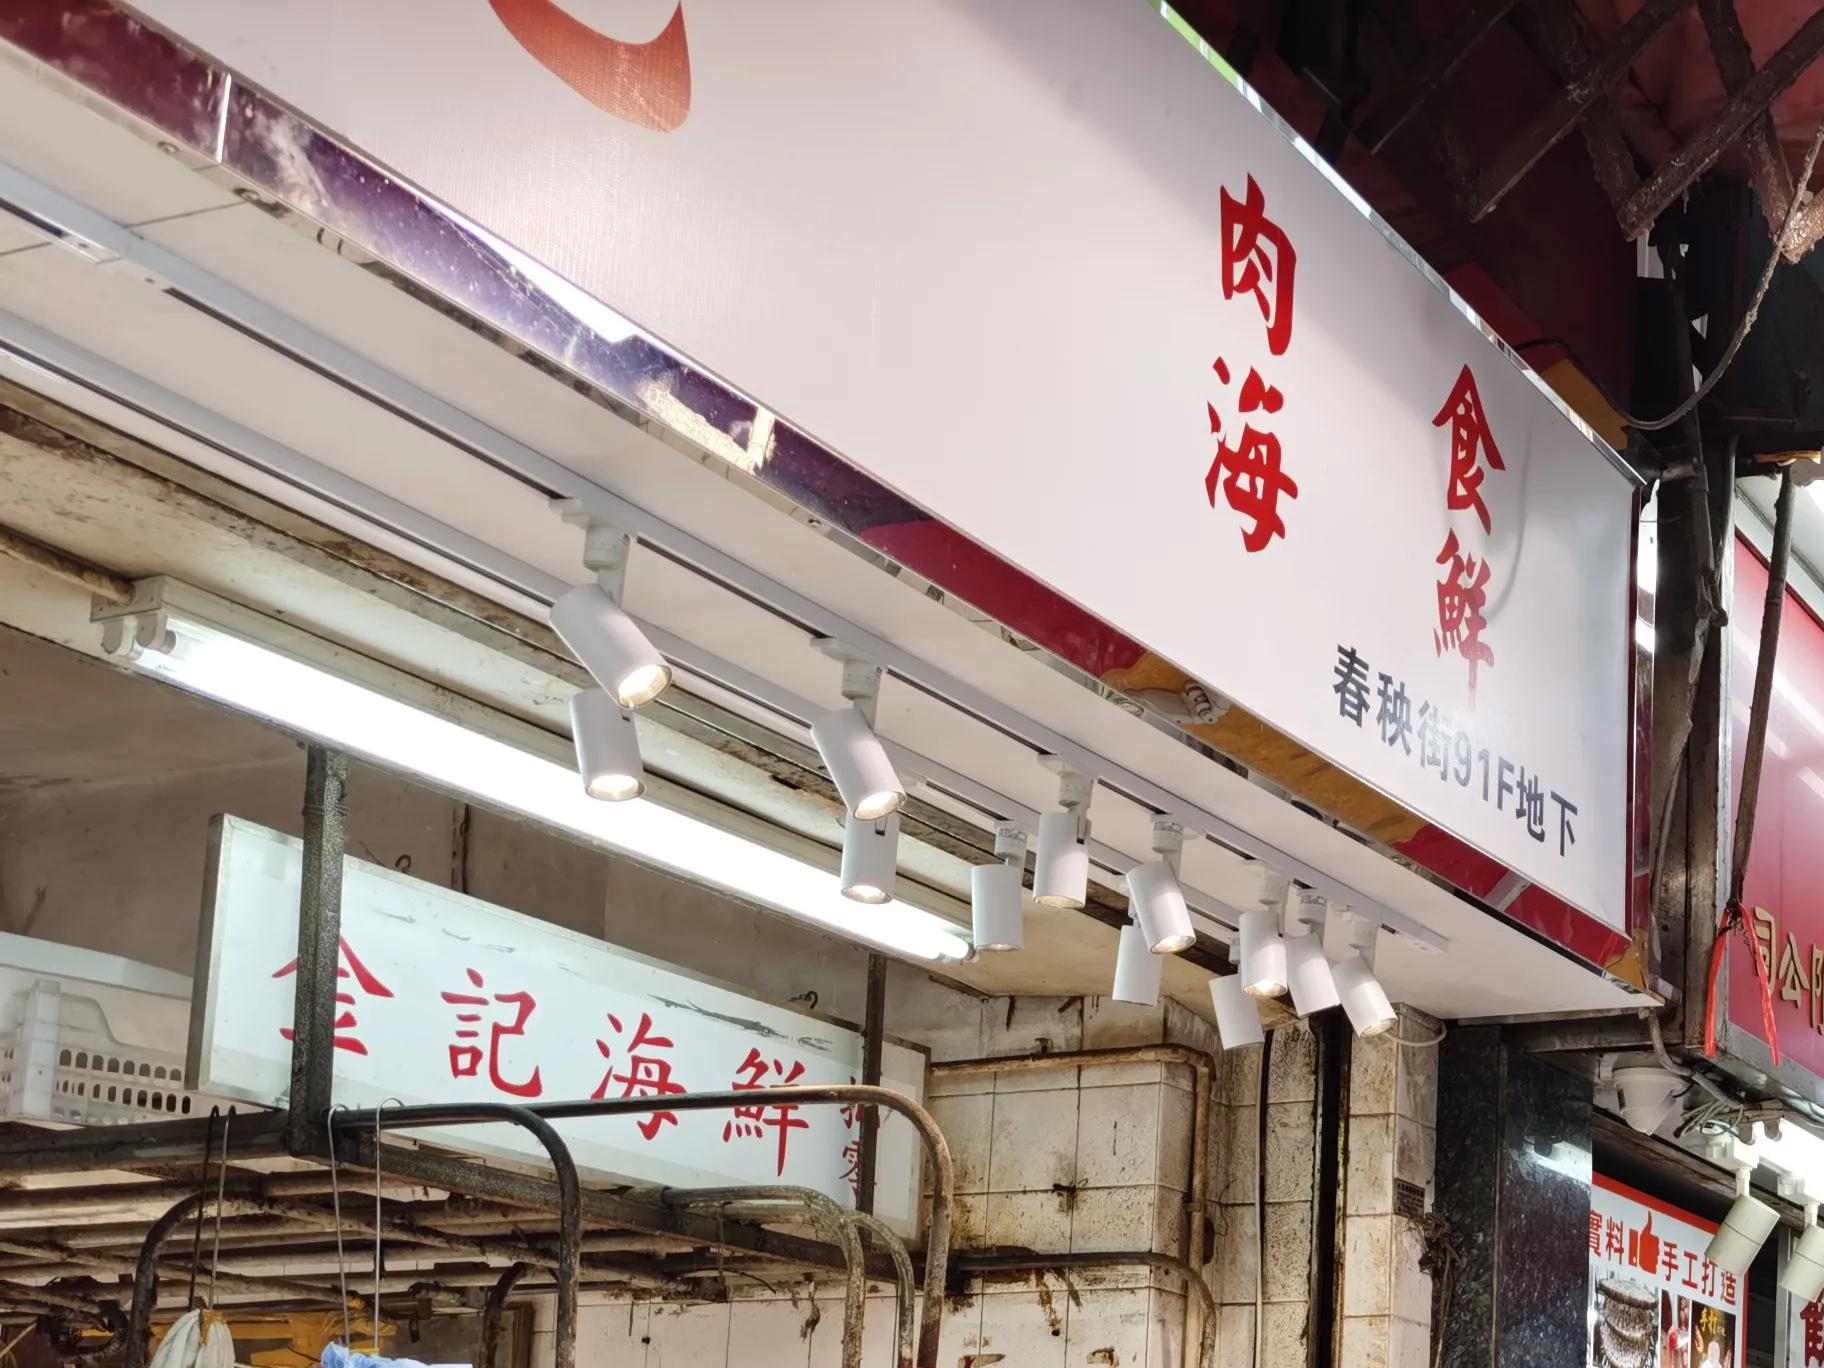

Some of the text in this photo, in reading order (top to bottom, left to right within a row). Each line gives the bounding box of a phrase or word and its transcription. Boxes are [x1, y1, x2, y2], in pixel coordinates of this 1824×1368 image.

[1332, 644, 1579, 857] 春秧街91F地下
[1662, 1241, 1737, 1306] 手工打造
